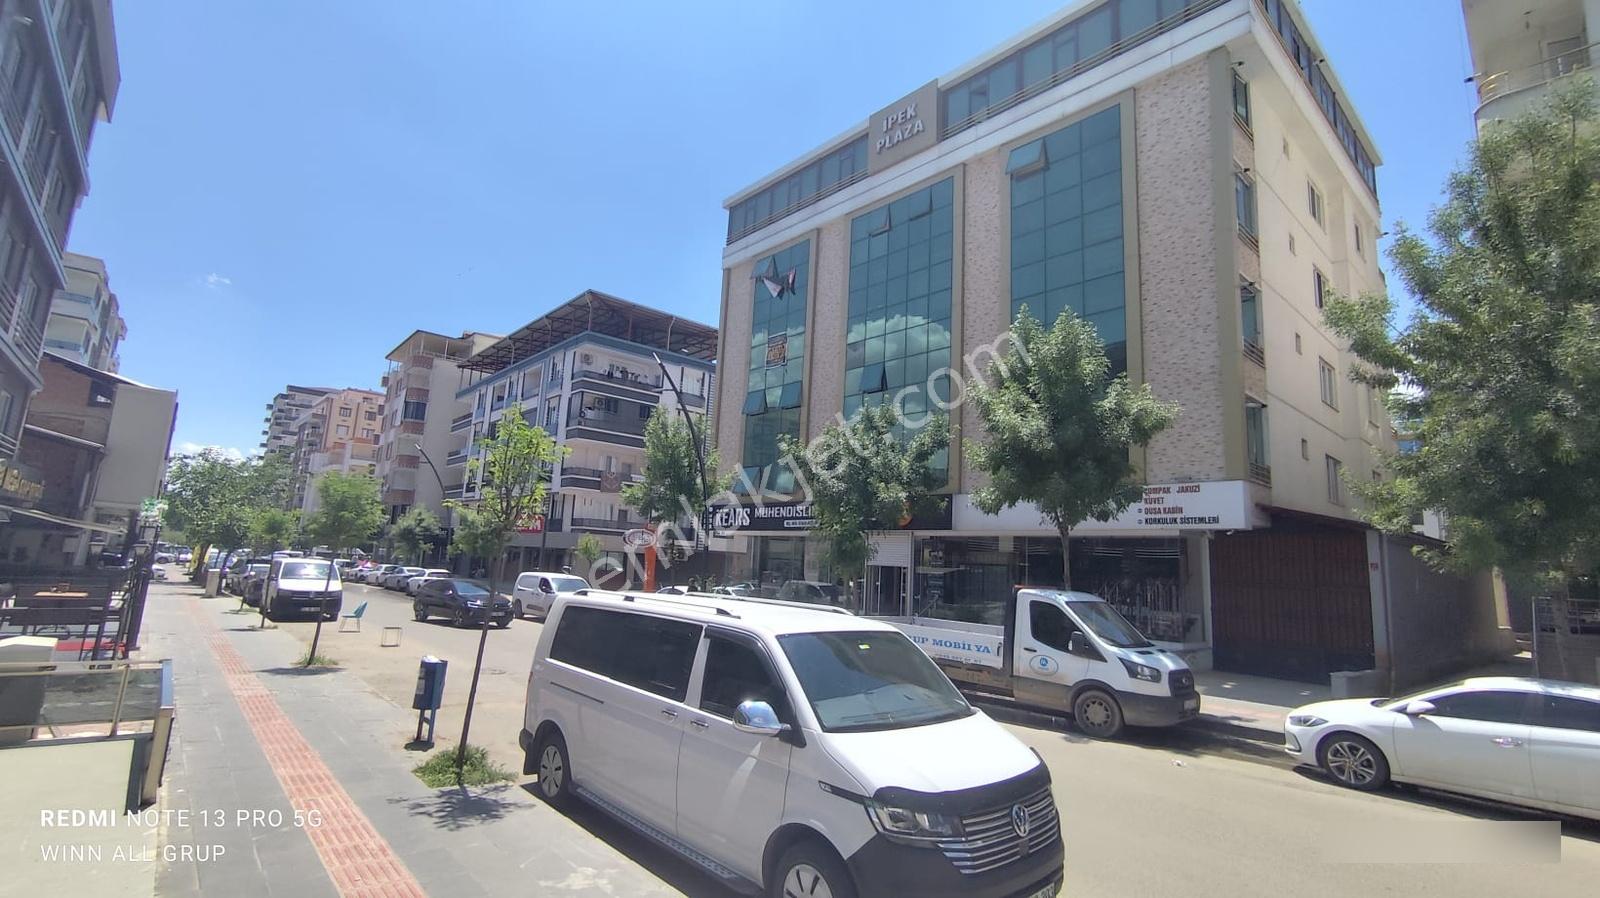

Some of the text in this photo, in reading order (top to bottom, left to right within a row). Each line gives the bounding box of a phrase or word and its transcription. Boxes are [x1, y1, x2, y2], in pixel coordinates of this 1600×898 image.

[876, 120, 924, 153] PLAZA
[714, 508, 751, 527] KEARS
[1144, 516, 1178, 525] KORKULUK
[908, 635, 929, 644] UP
